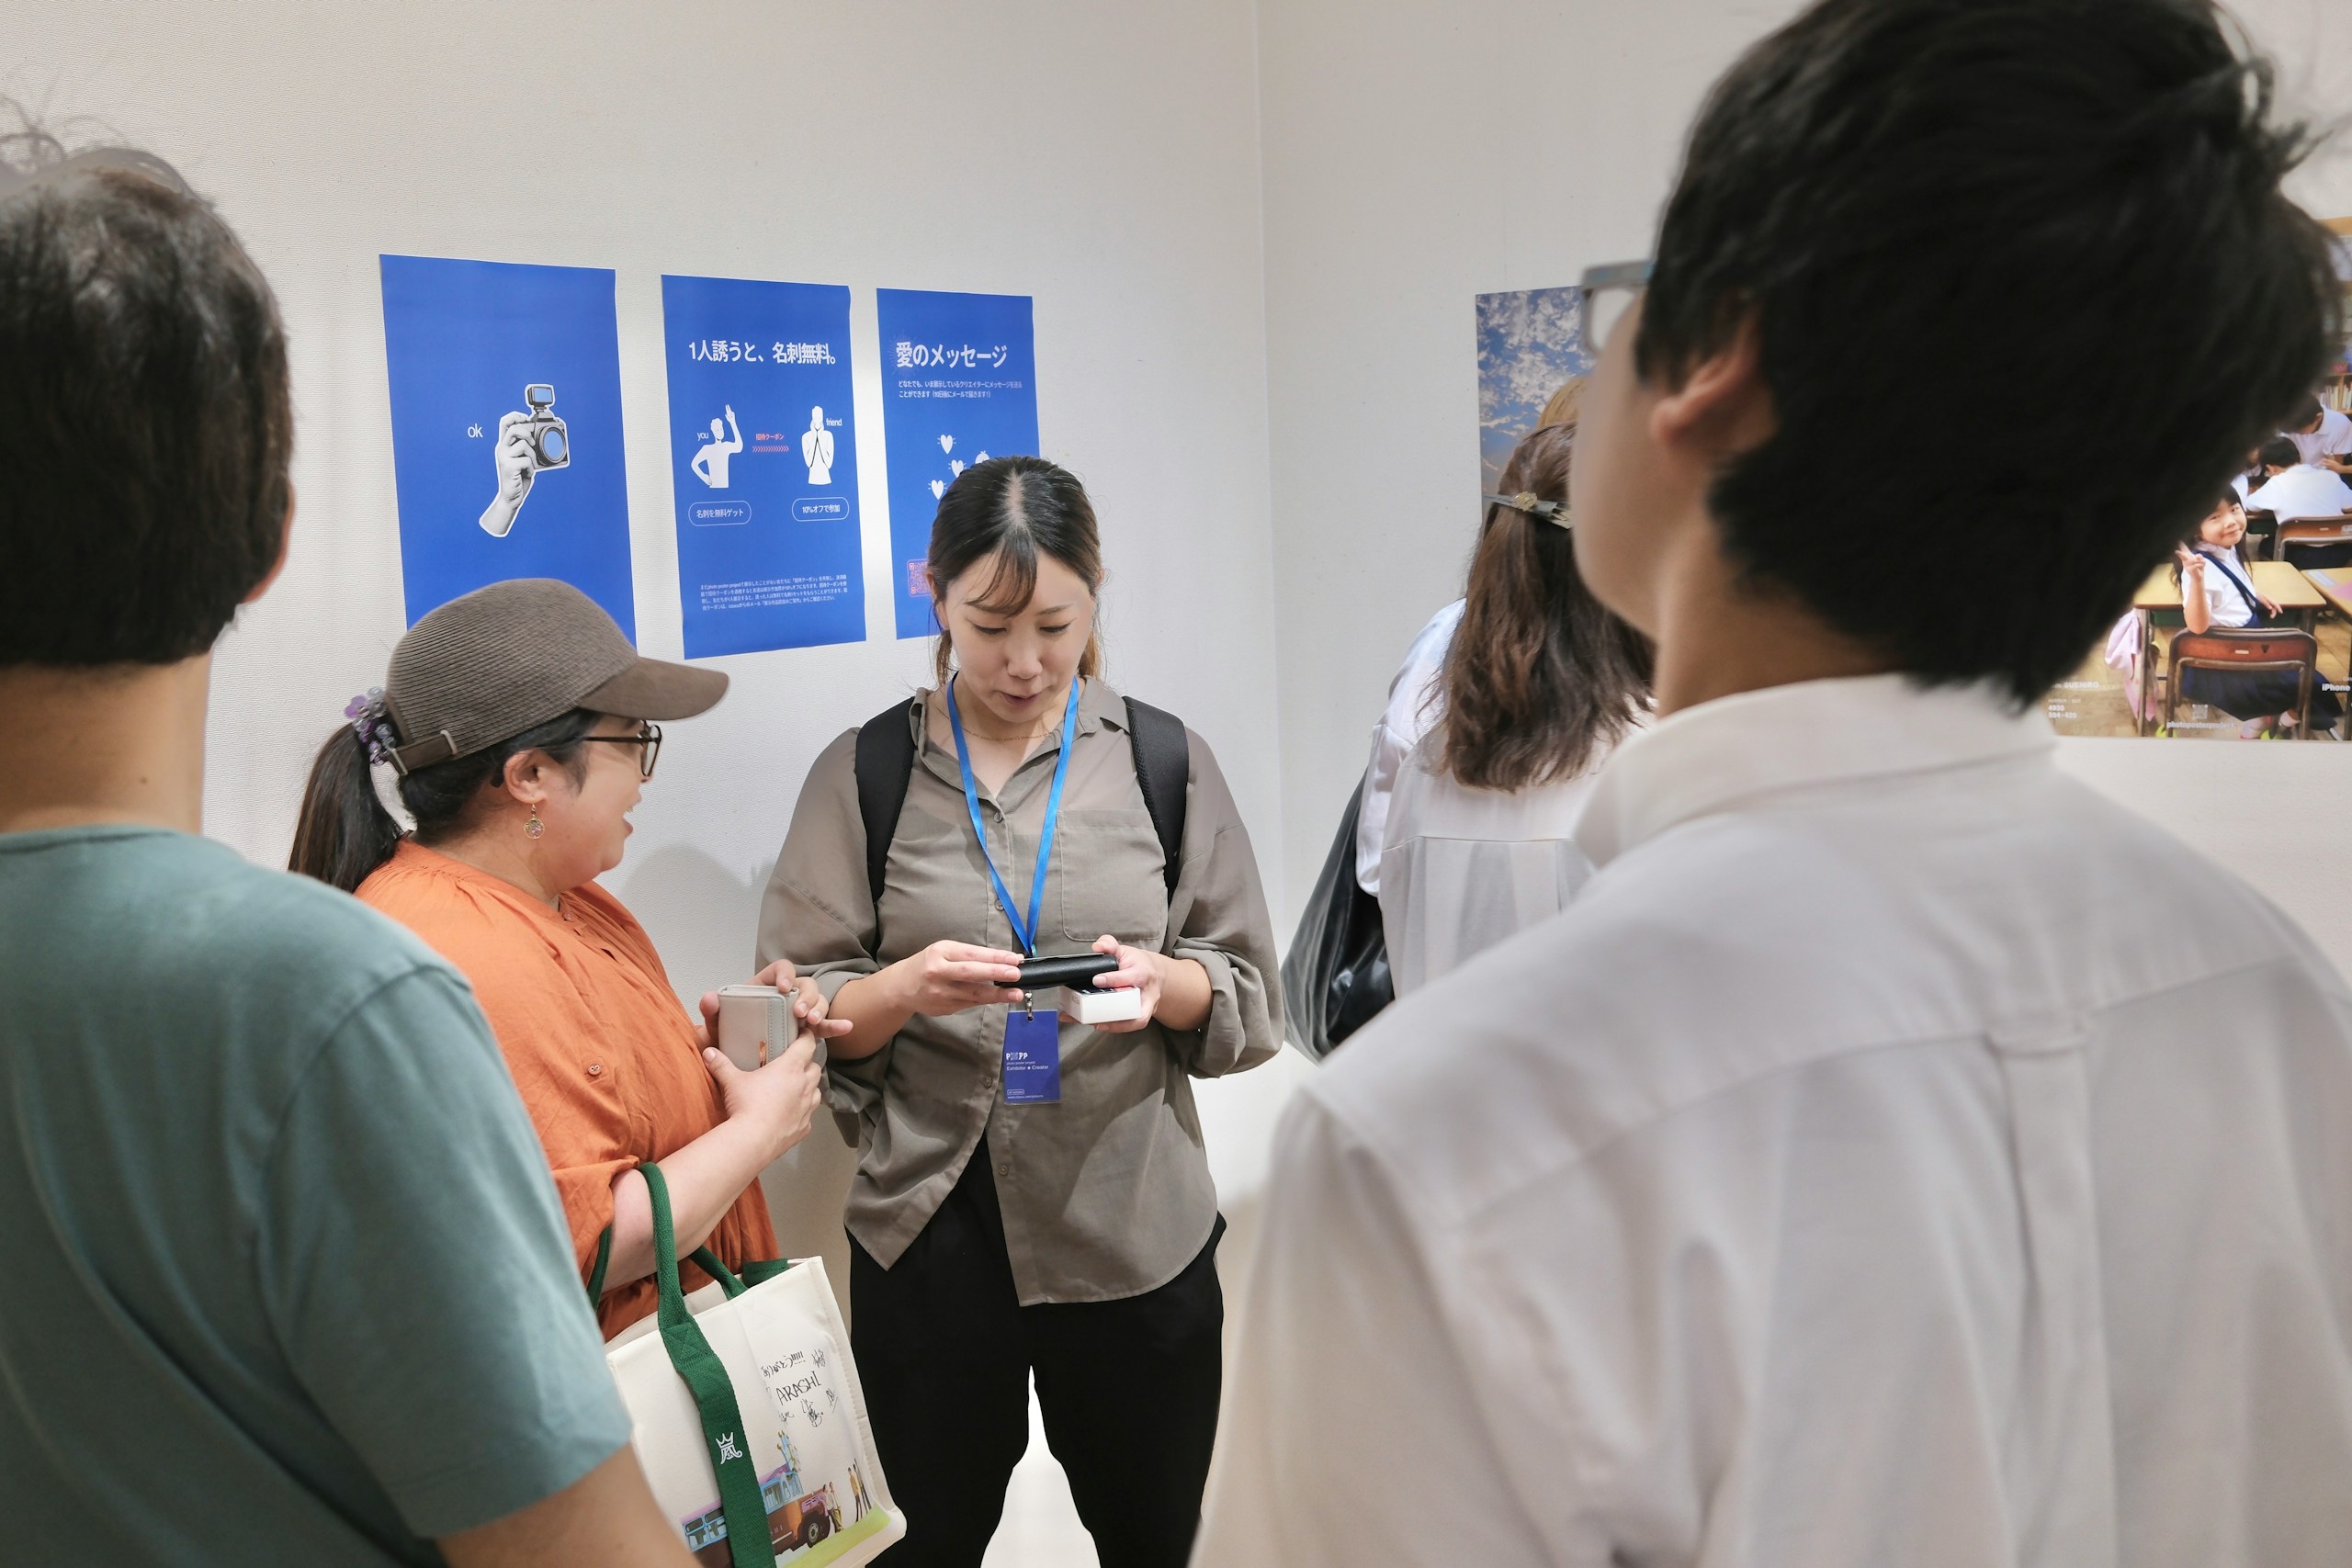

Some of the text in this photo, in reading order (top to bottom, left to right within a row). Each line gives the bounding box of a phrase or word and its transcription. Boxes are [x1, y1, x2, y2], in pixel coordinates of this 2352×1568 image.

[688, 339, 836, 365] 1人誘うと、名刺無料。
[896, 341, 1008, 368] 愛のメッセージ
[826, 418, 842, 427] friend
[468, 423, 483, 438] ok
[696, 432, 709, 441] you
[755, 433, 785, 441] 招待クーポン
[695, 507, 744, 519] 名刺を無料ゲット
[801, 503, 841, 514] 10%オフで参加
[2322, 683, 2351, 692] iPhone
[775, 1371, 822, 1406] ARASHI
